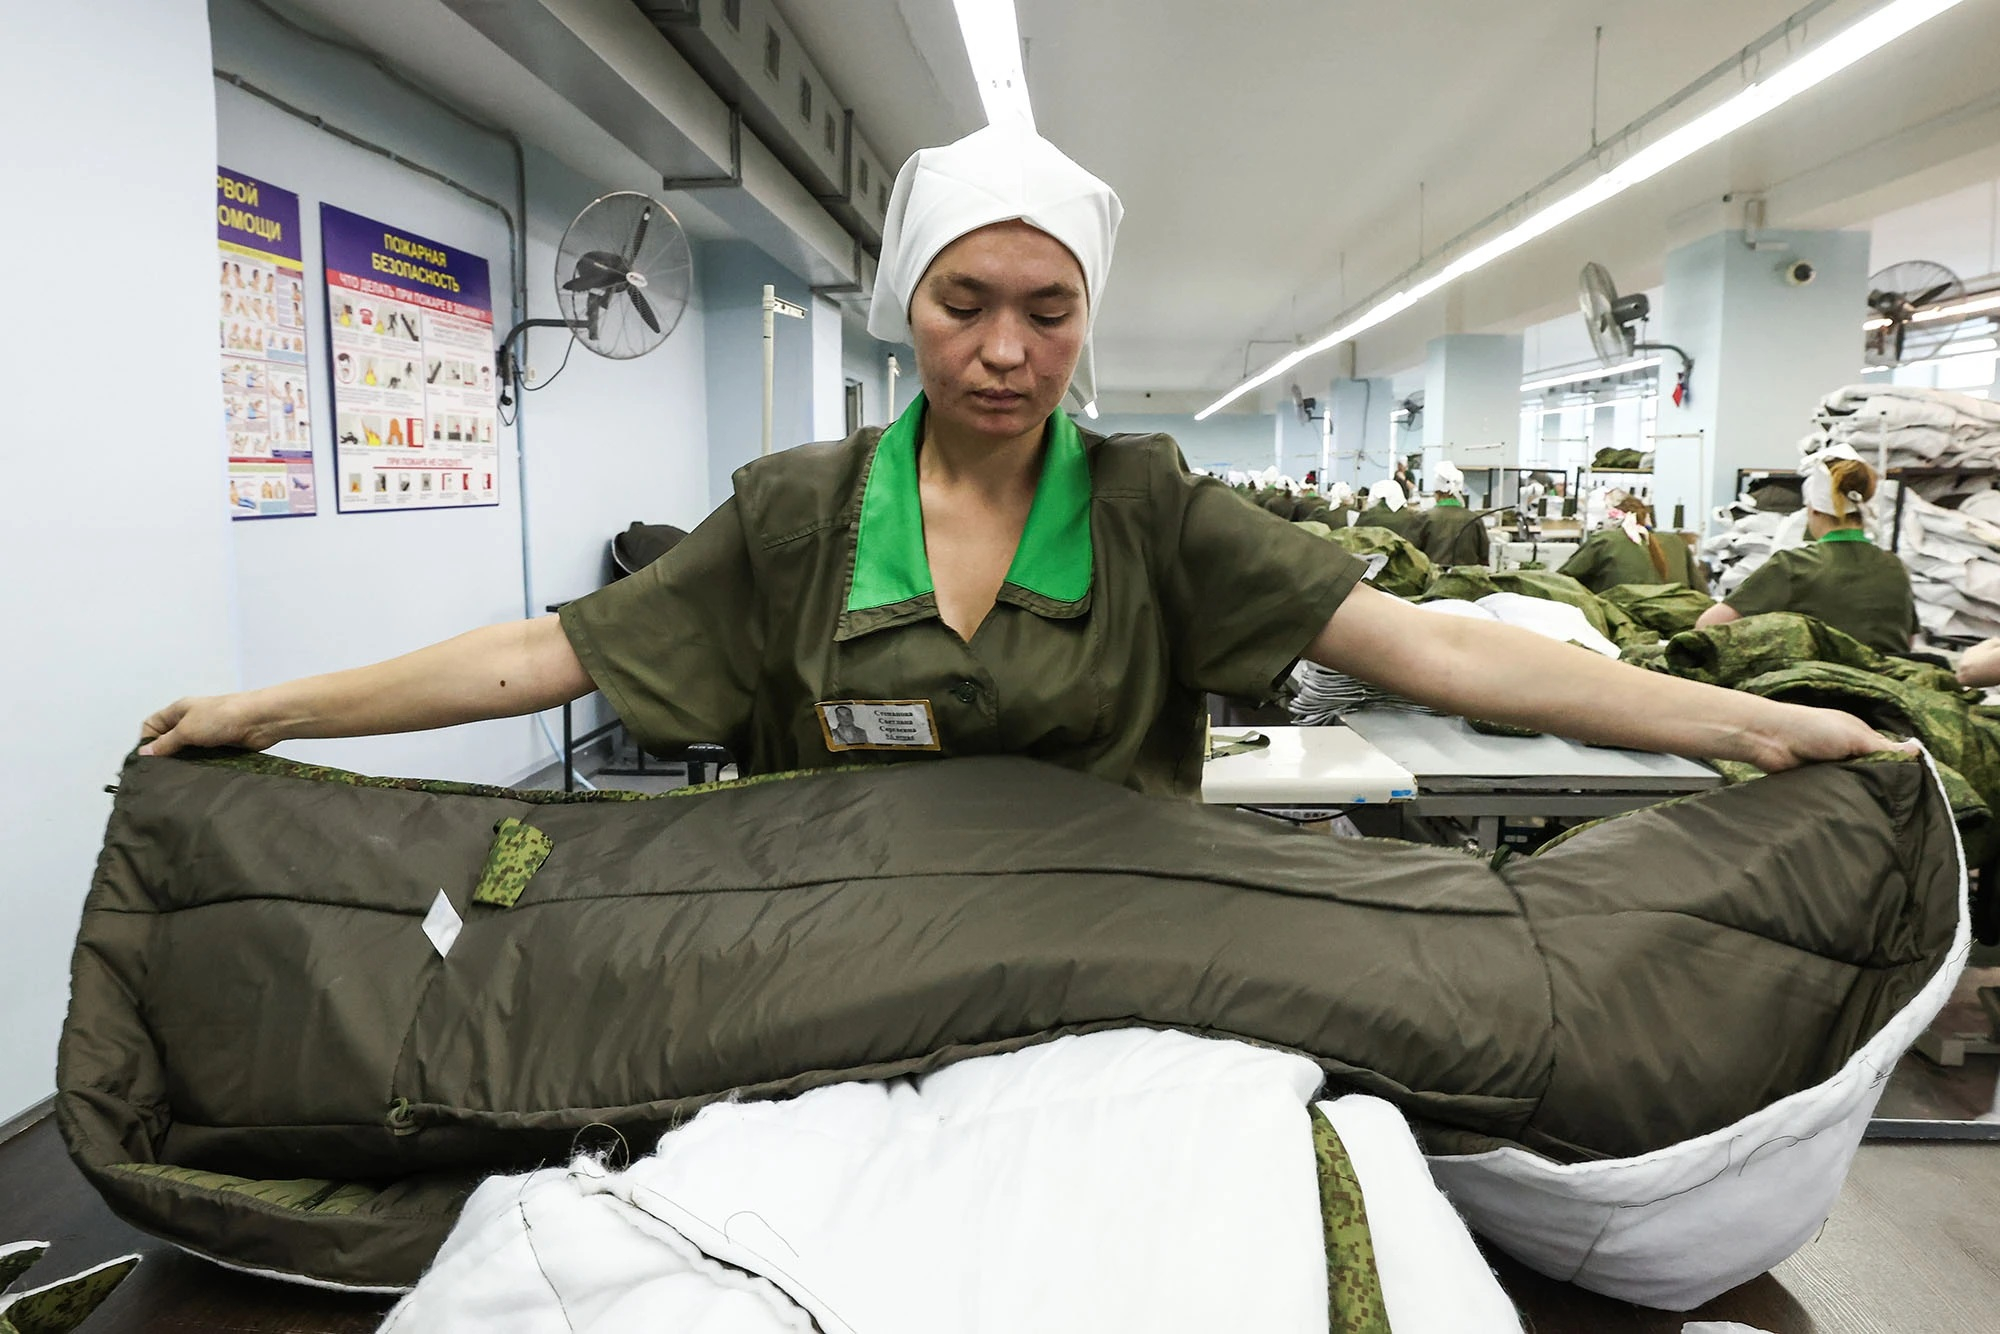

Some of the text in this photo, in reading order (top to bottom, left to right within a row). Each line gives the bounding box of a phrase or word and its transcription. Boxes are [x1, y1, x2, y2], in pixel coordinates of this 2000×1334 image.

[384, 233, 447, 268] ПОЖАРНАЯ
[372, 252, 460, 292] БЕЗОПАСНОСТЬ
[339, 273, 359, 289] ЧТО
[360, 278, 395, 297] ДЕЛАТЬ
[396, 287, 413, 301] ПРИ
[414, 291, 446, 310] ПОЖАРЕ
